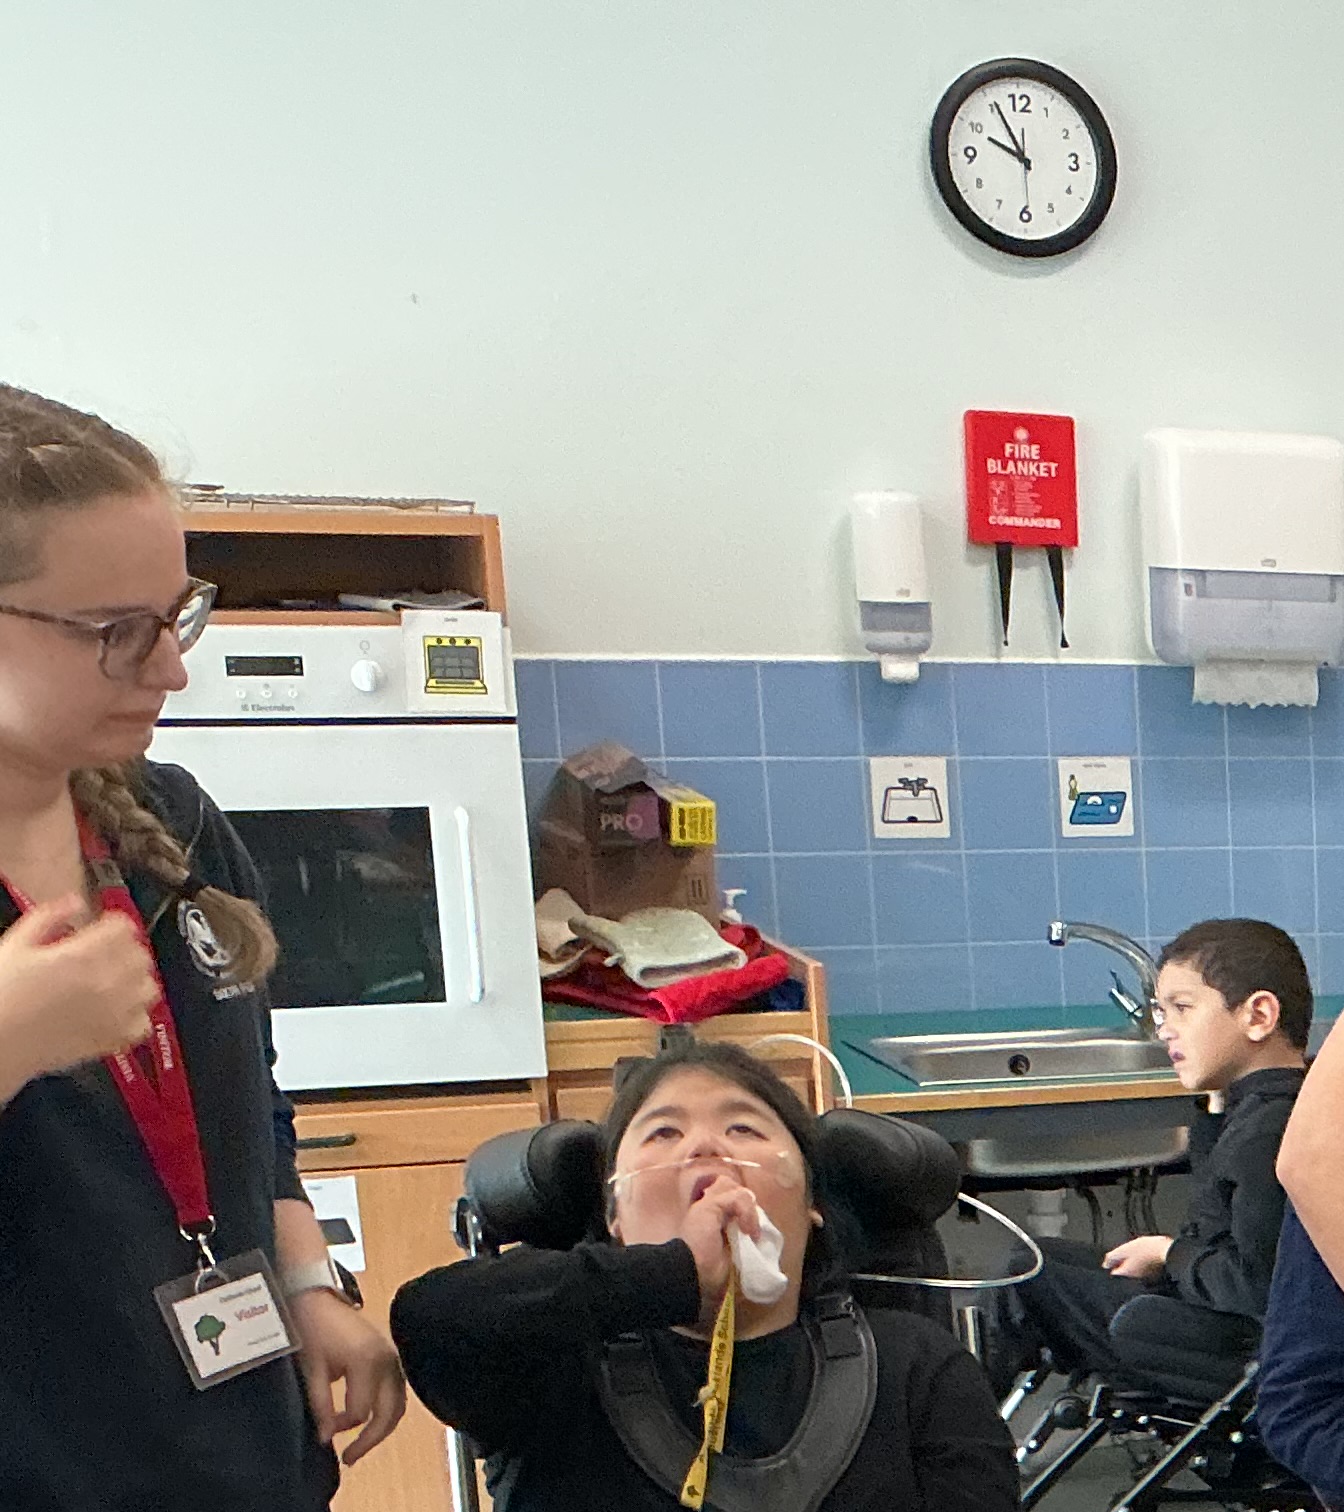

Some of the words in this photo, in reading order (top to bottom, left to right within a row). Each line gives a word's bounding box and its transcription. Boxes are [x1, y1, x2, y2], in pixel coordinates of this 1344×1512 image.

[1008, 93, 1032, 113] 12
[1044, 107, 1049, 118] 1
[968, 121, 983, 134] 10
[1062, 128, 1070, 140] 2
[963, 146, 977, 165] 9
[1068, 152, 1080, 172] 3
[975, 177, 983, 189] 8
[995, 199, 1002, 209] 7
[1047, 203, 1055, 214] 5
[1019, 204, 1032, 223] 6
[1004, 442, 1040, 460] FIRE
[986, 458, 1058, 477] BLANKET
[988, 515, 1061, 529] COMMANDER
[600, 813, 643, 832] PRO
